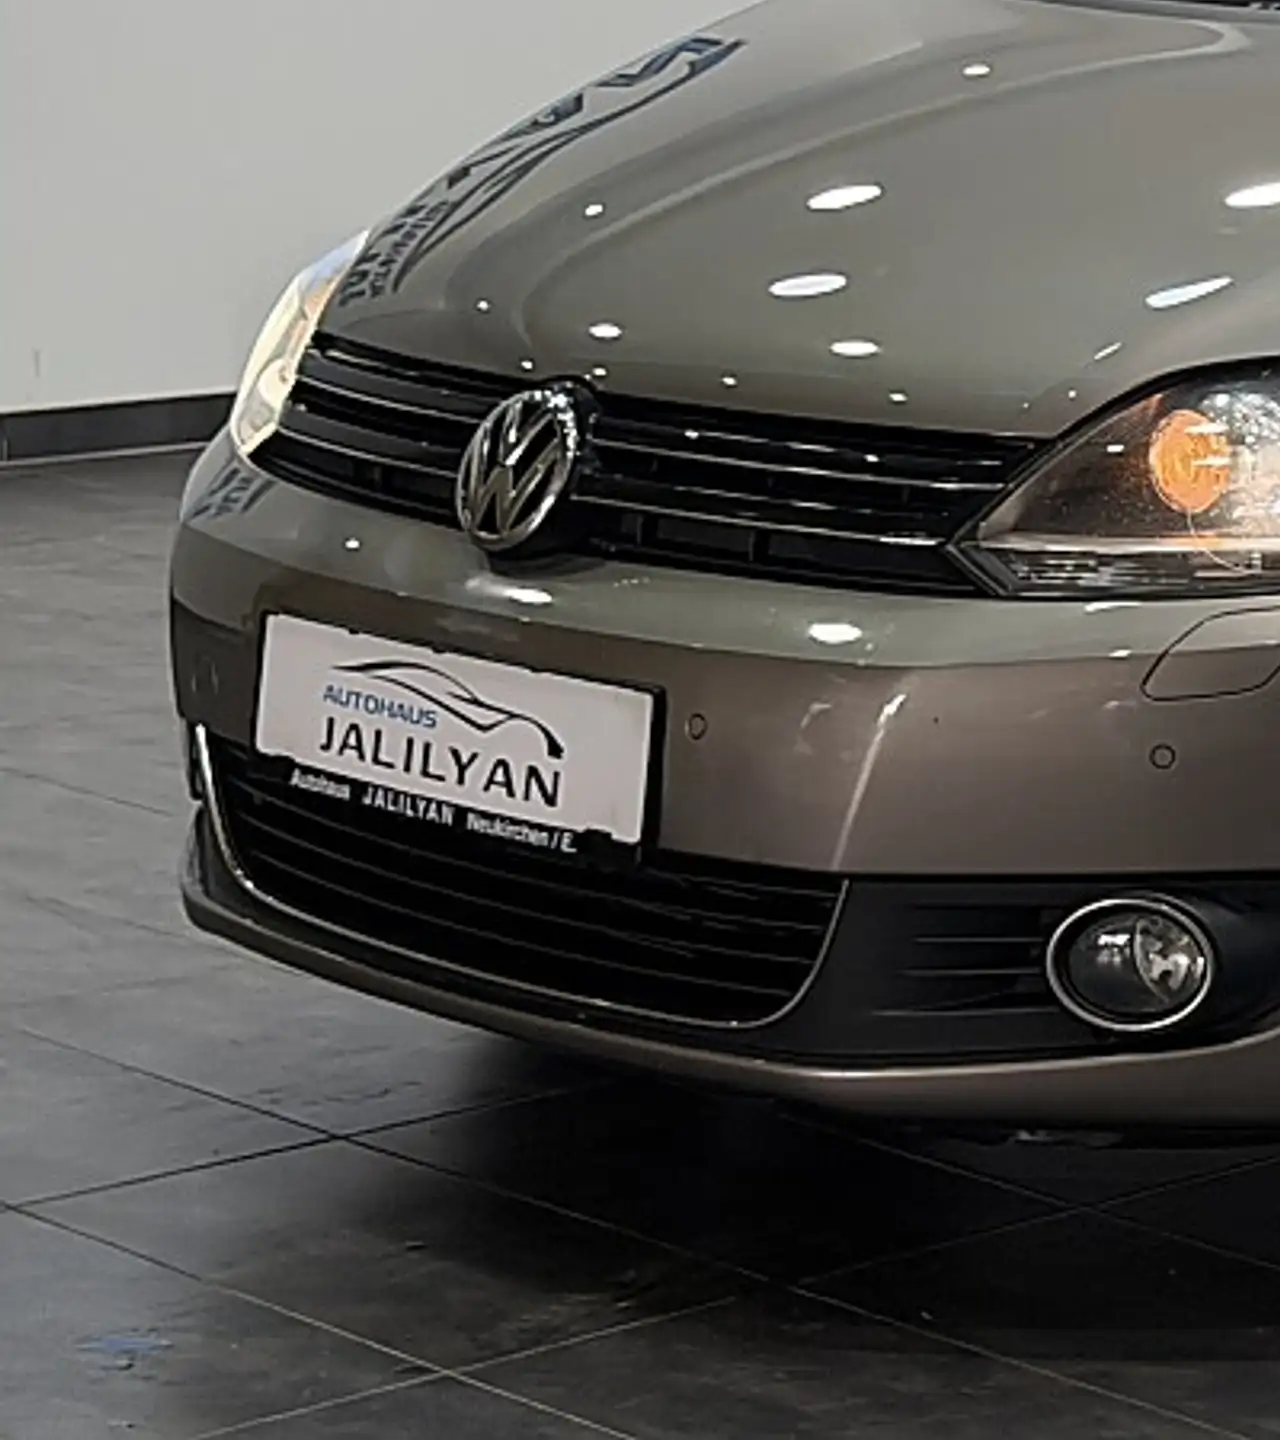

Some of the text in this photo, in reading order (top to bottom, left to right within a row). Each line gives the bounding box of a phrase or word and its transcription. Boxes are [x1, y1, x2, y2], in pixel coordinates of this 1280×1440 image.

[322, 684, 438, 730] AUTOHAUS
[319, 715, 561, 809] JALILYAN
[288, 767, 351, 801] Autohaus
[361, 785, 455, 827] JALILYAN
